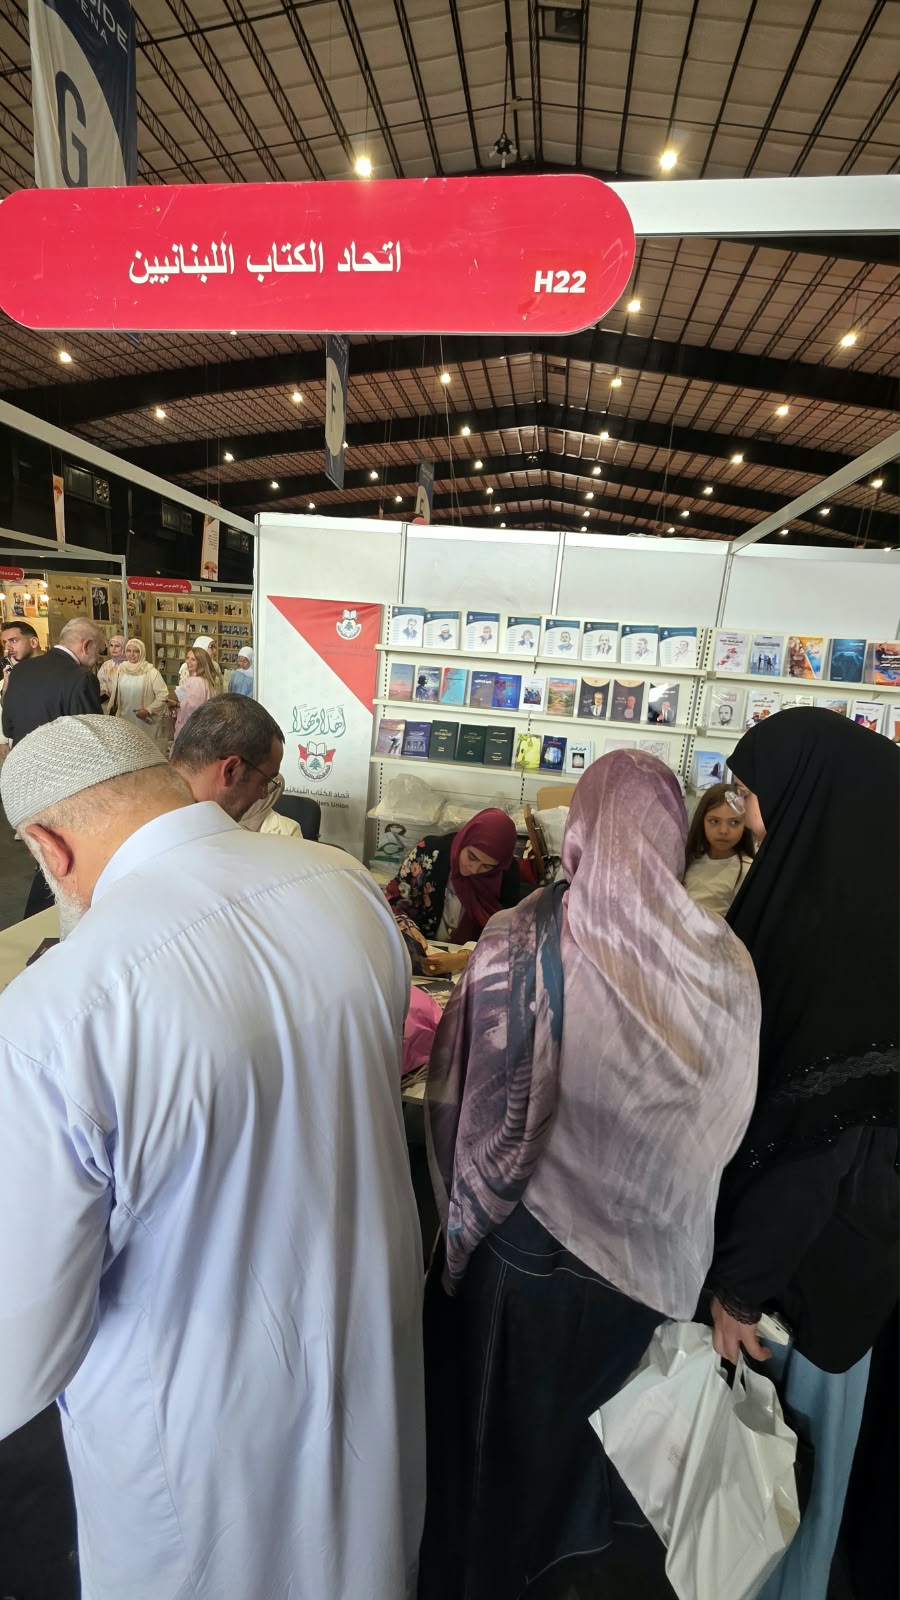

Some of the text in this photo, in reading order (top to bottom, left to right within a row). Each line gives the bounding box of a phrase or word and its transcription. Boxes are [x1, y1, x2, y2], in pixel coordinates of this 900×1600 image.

[75, 0, 109, 46] ENA
[90, 0, 128, 54] IDE
[55, 70, 88, 189] G
[128, 239, 402, 285] اتحاد الكتاب اللبنانيين
[533, 269, 587, 294] H22
[330, 801, 350, 809] Union
